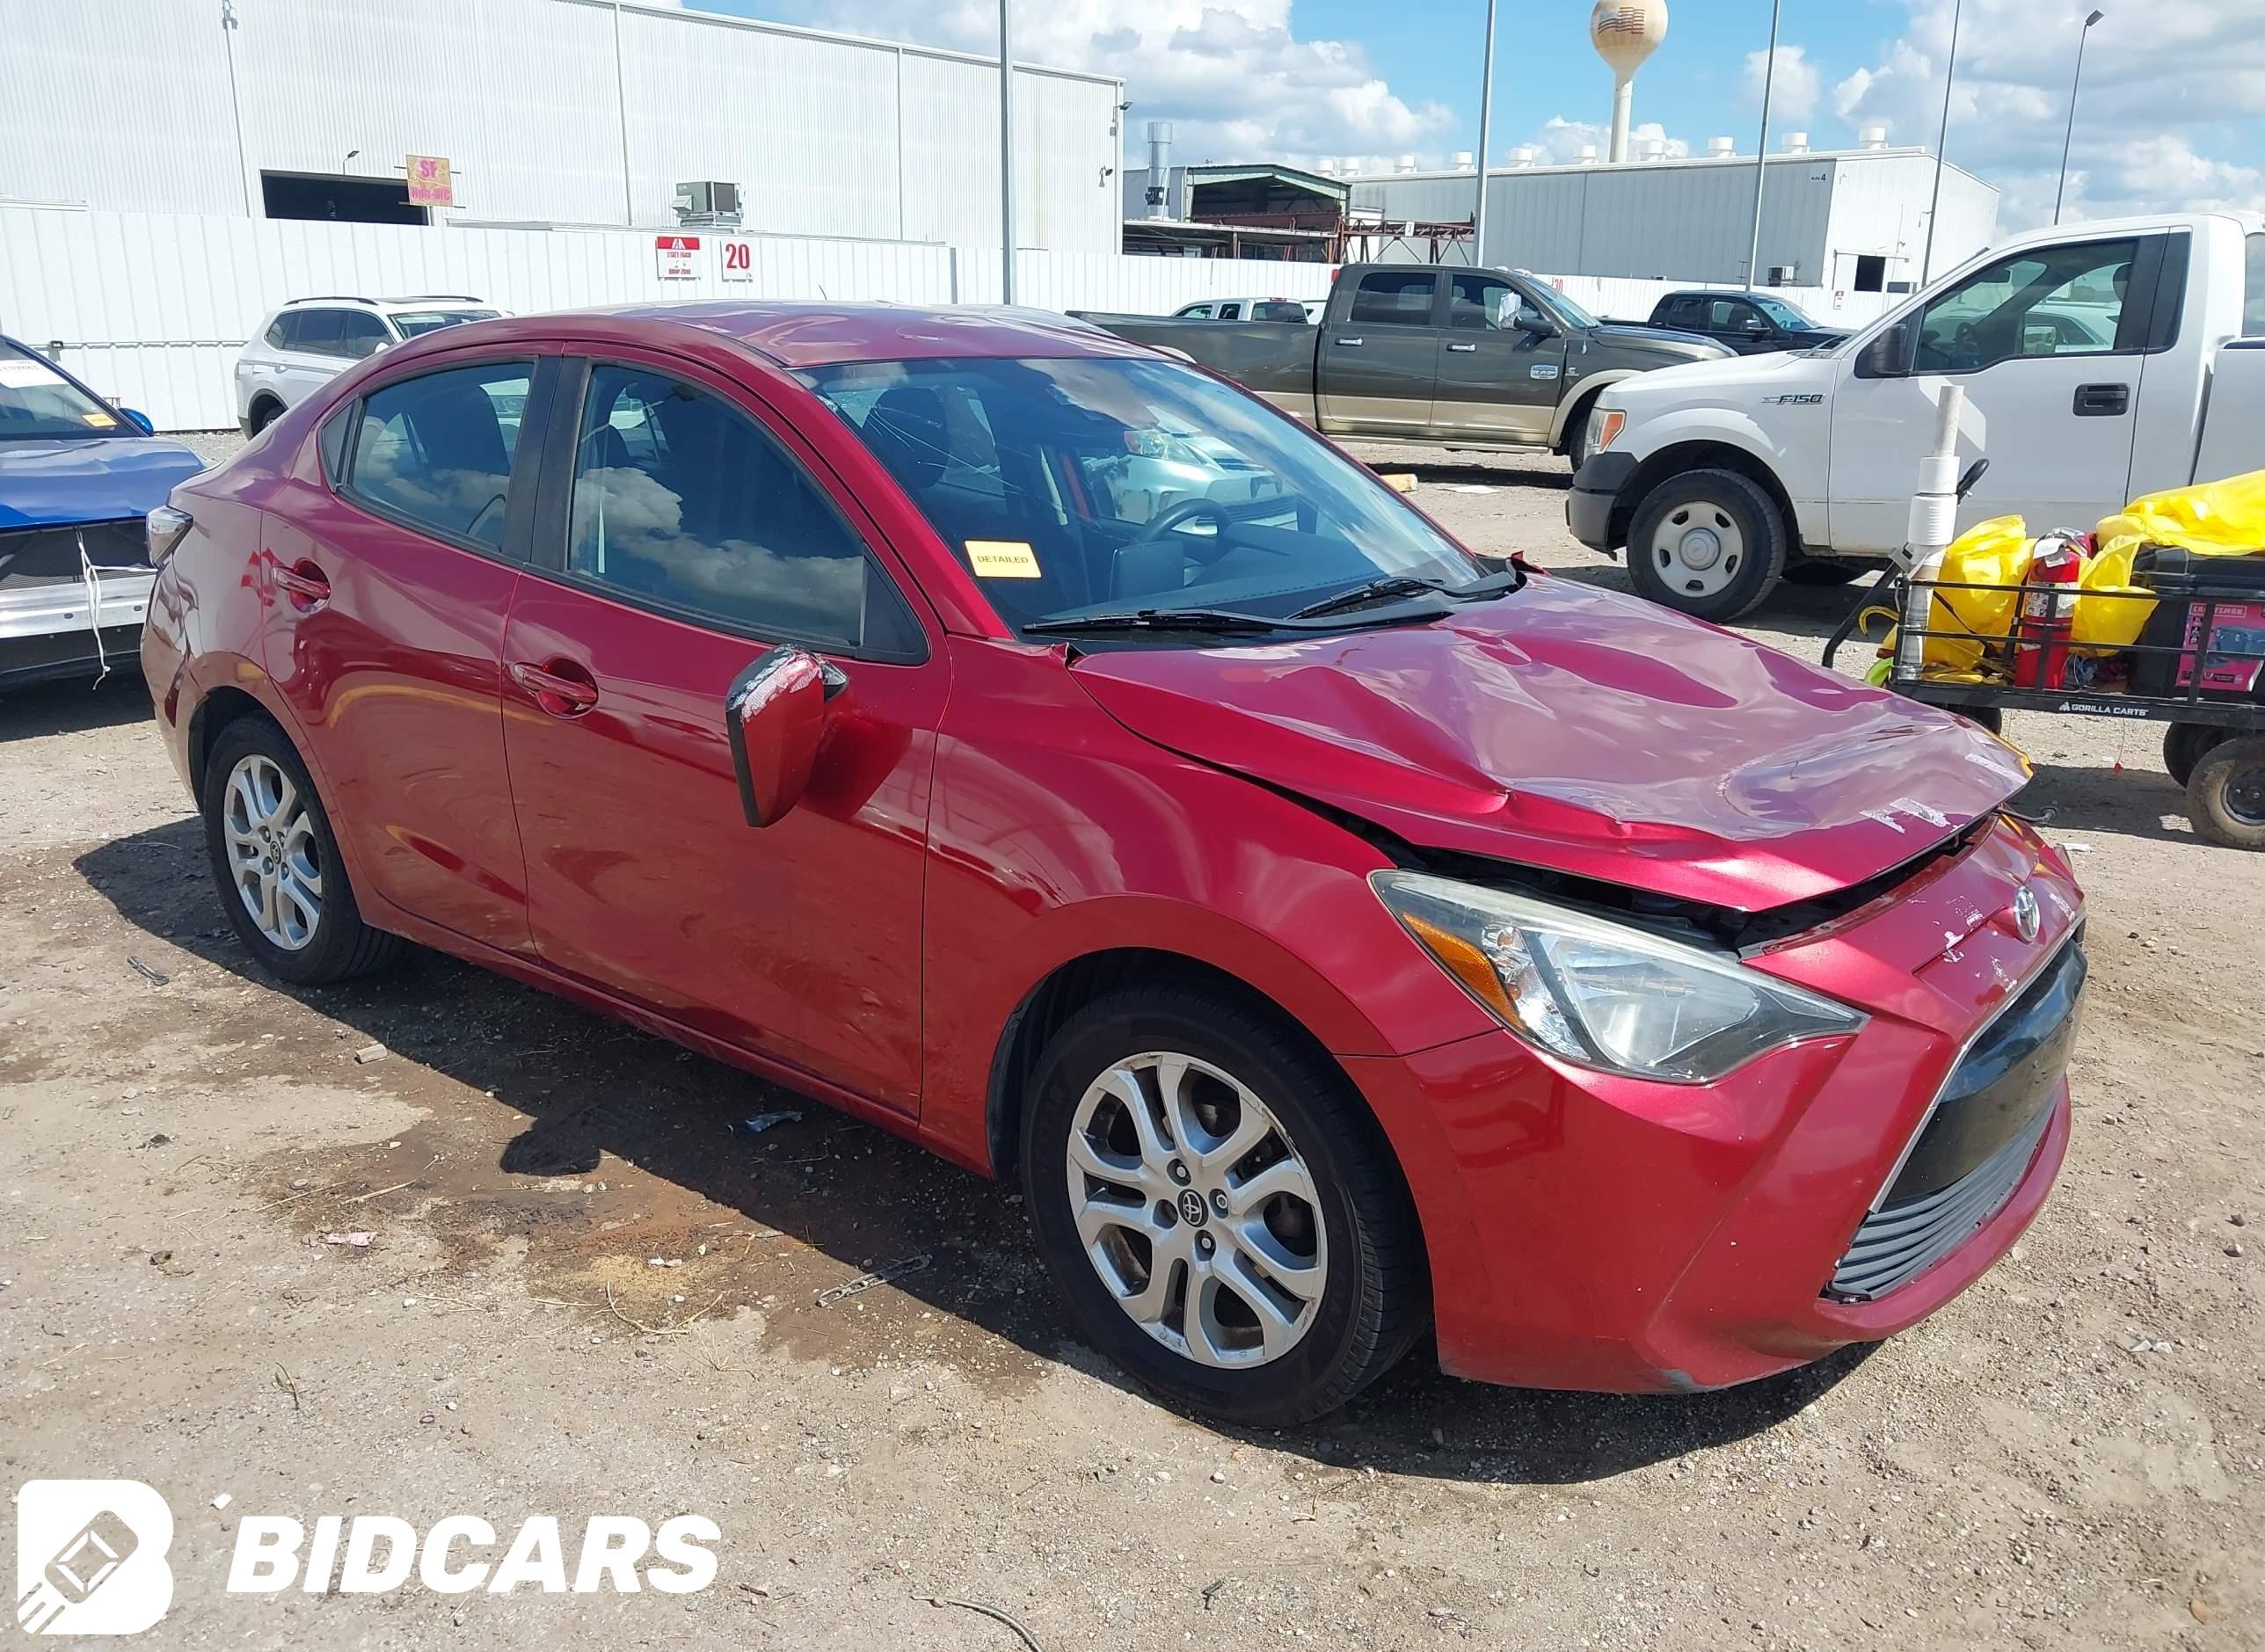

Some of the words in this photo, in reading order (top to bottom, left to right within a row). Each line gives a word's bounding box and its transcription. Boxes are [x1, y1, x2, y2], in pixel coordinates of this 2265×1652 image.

[419, 159, 437, 178] SF
[725, 244, 750, 269] 20
[1779, 394, 1824, 404] F-150
[2071, 703, 2111, 713] GORILLA
[2113, 707, 2146, 717] CARTS
